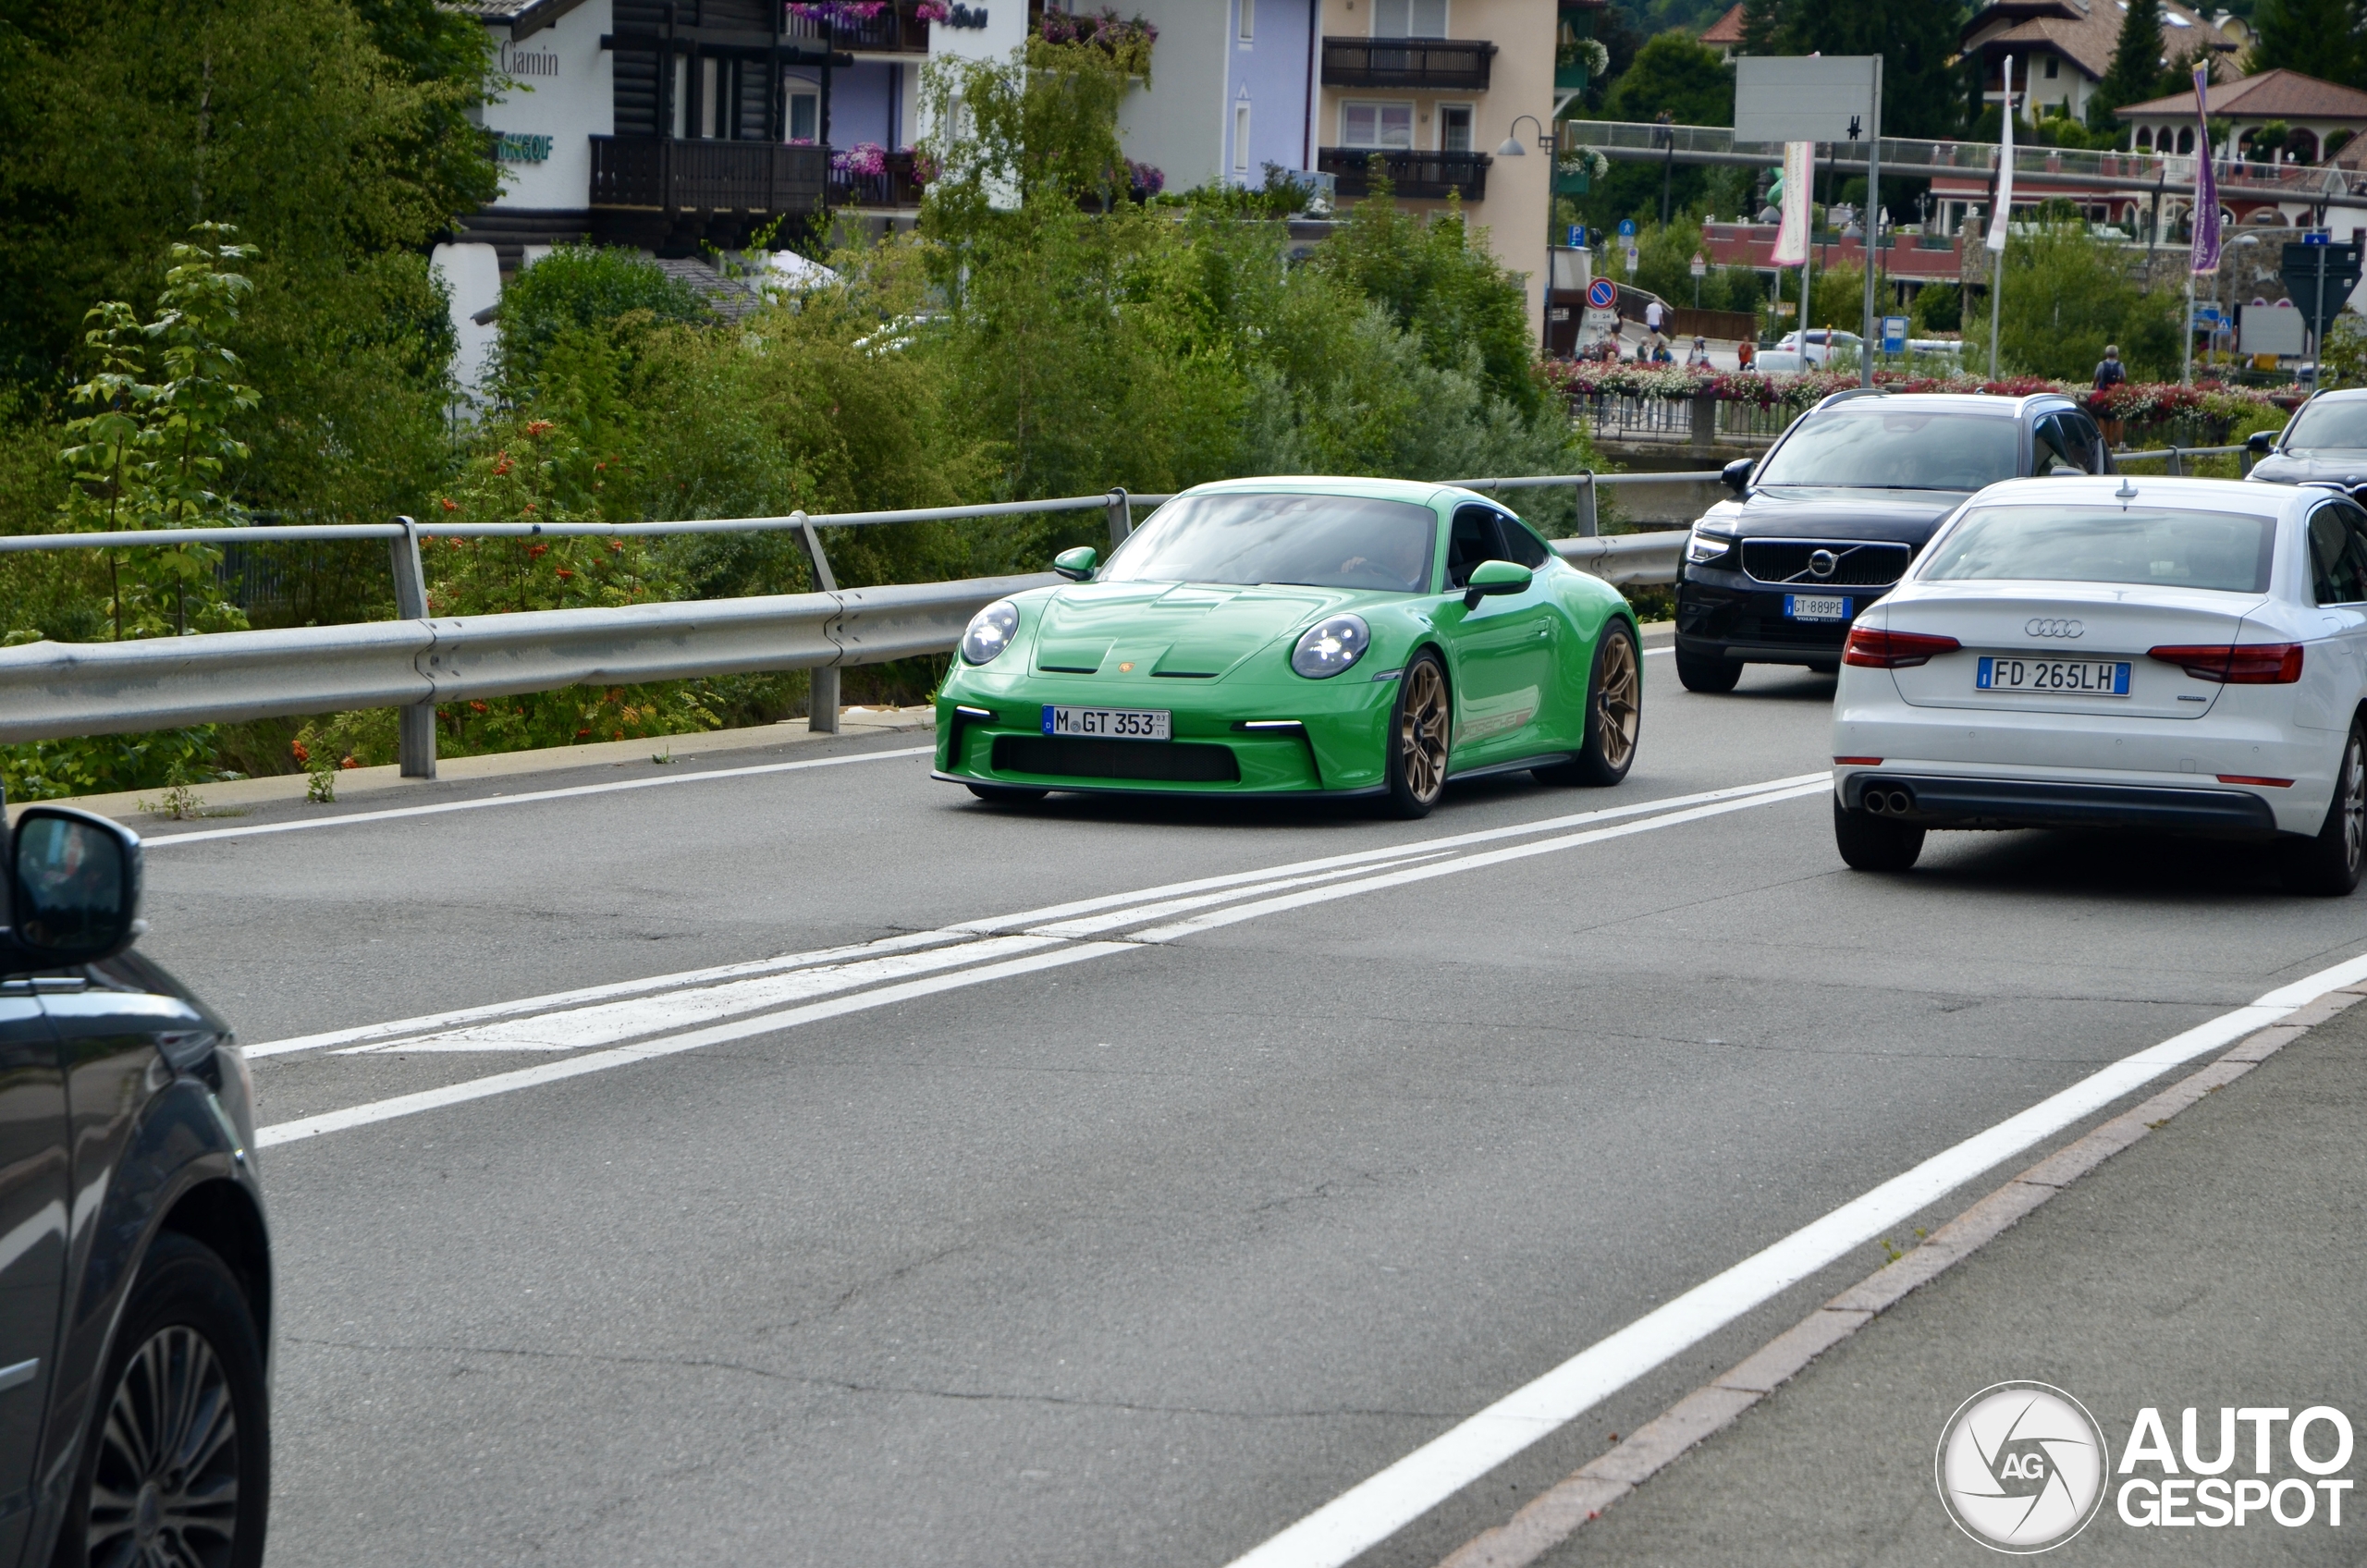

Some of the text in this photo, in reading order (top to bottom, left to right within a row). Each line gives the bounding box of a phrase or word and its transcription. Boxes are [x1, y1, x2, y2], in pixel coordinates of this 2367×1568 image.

[500, 39, 558, 76] Ciamin
[1573, 226, 1581, 239] P
[1779, 302, 1794, 311] TAXI
[1994, 661, 2113, 690] FD 265LH
[1056, 710, 1154, 735] M GT 353
[1462, 715, 1515, 737] PORSCHE
